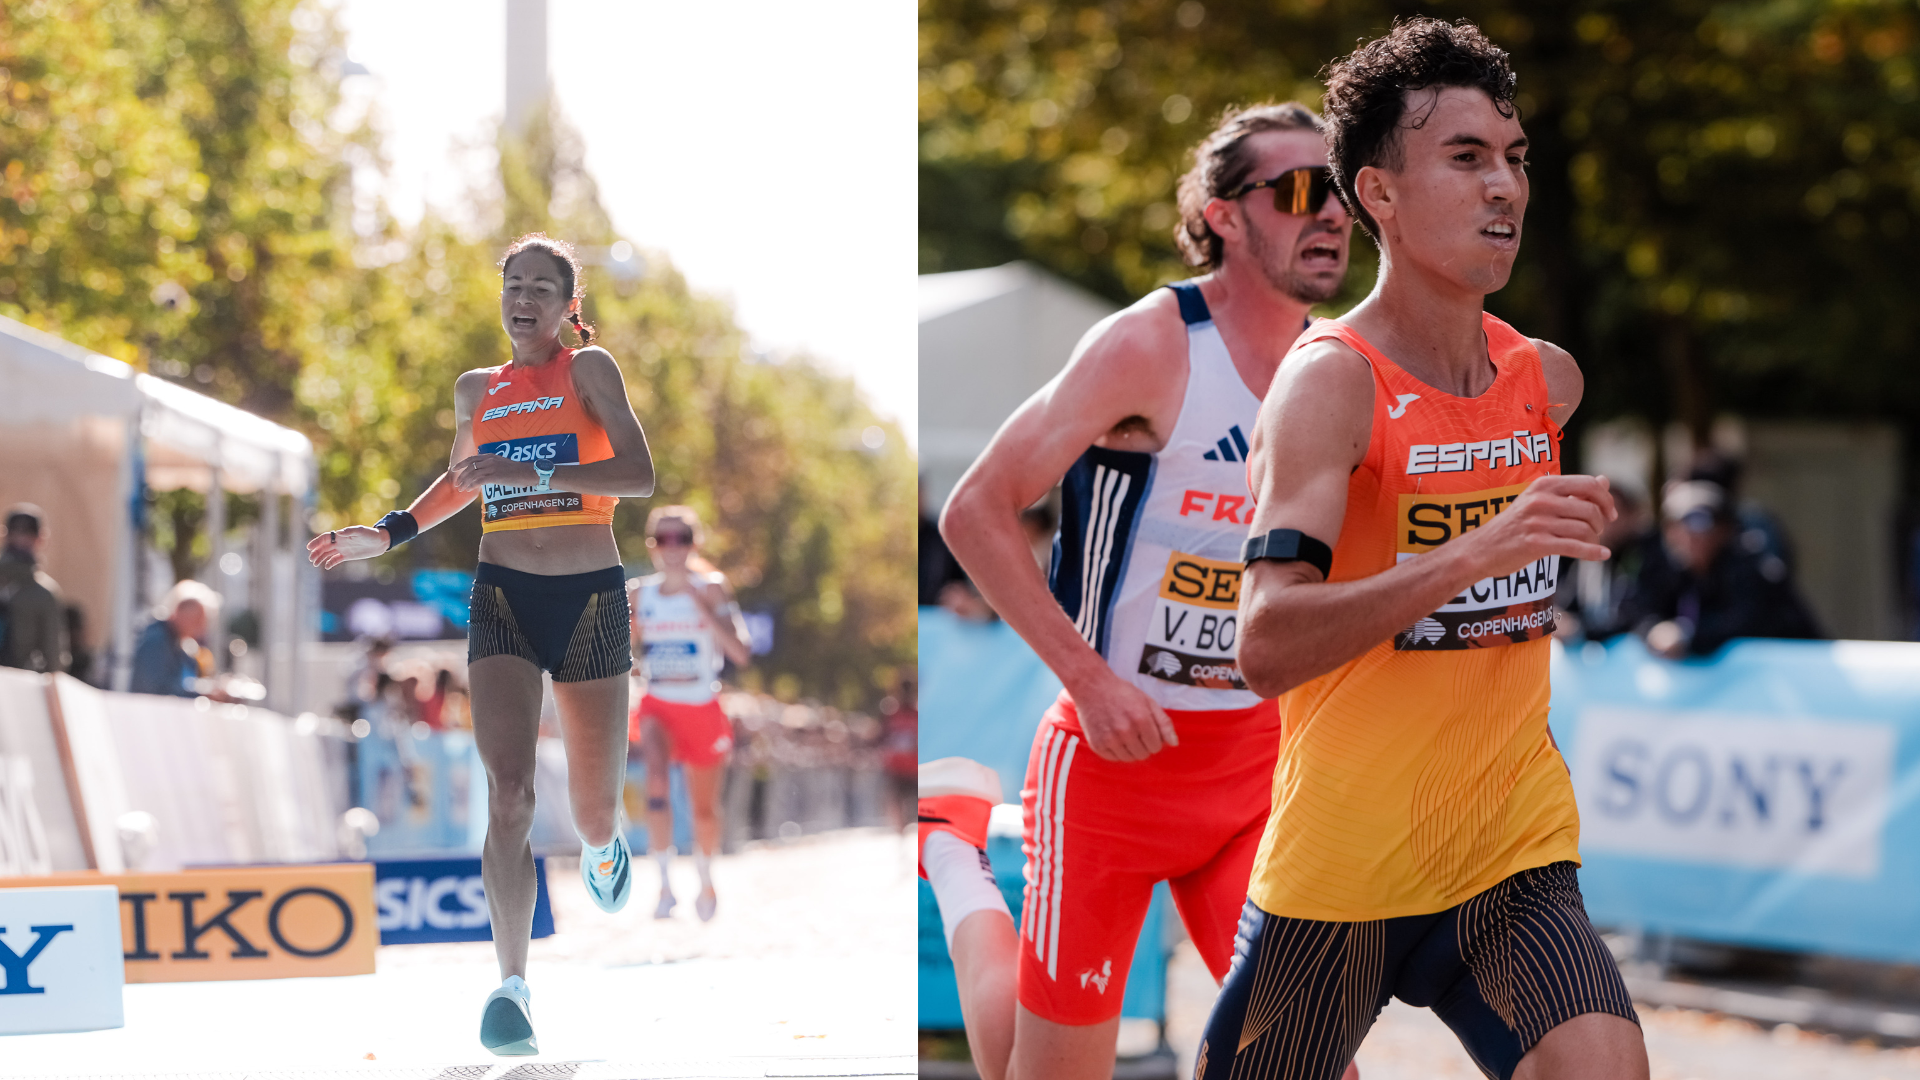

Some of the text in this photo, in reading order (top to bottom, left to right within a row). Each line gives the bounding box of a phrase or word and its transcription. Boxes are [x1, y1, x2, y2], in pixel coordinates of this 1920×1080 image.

[481, 396, 565, 422] ESPAÑA
[1406, 430, 1552, 475] ESPAÑA
[501, 498, 565, 513] COPENHAGEN
[1168, 560, 1242, 603] SE
[1164, 606, 1237, 652] V. BO
[1457, 610, 1547, 639] COPENHAGEN
[1593, 738, 1849, 834] SONY
[120, 886, 356, 961] IKO
